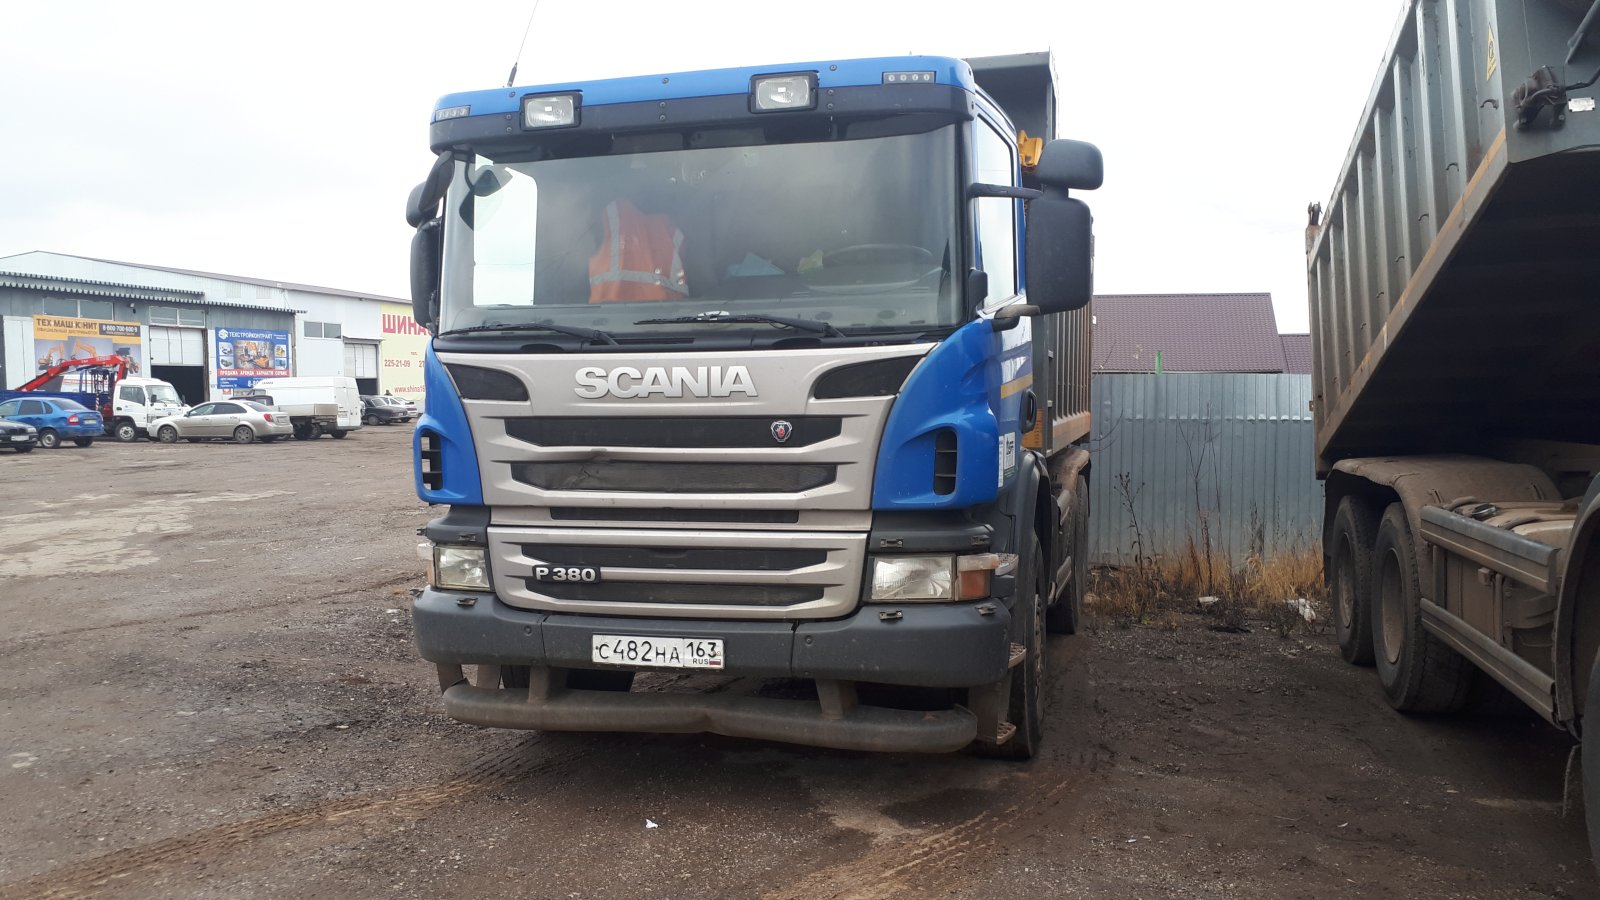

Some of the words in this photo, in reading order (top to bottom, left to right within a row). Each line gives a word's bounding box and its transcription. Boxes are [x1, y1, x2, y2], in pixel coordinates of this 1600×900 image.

[36, 318, 52, 327] ТЕХ
[53, 320, 74, 329] МАШ
[384, 359, 411, 368] 225-21-09
[574, 365, 758, 399] SCANIA
[536, 567, 549, 580] P
[552, 567, 596, 582] 380
[686, 641, 718, 658] 163
